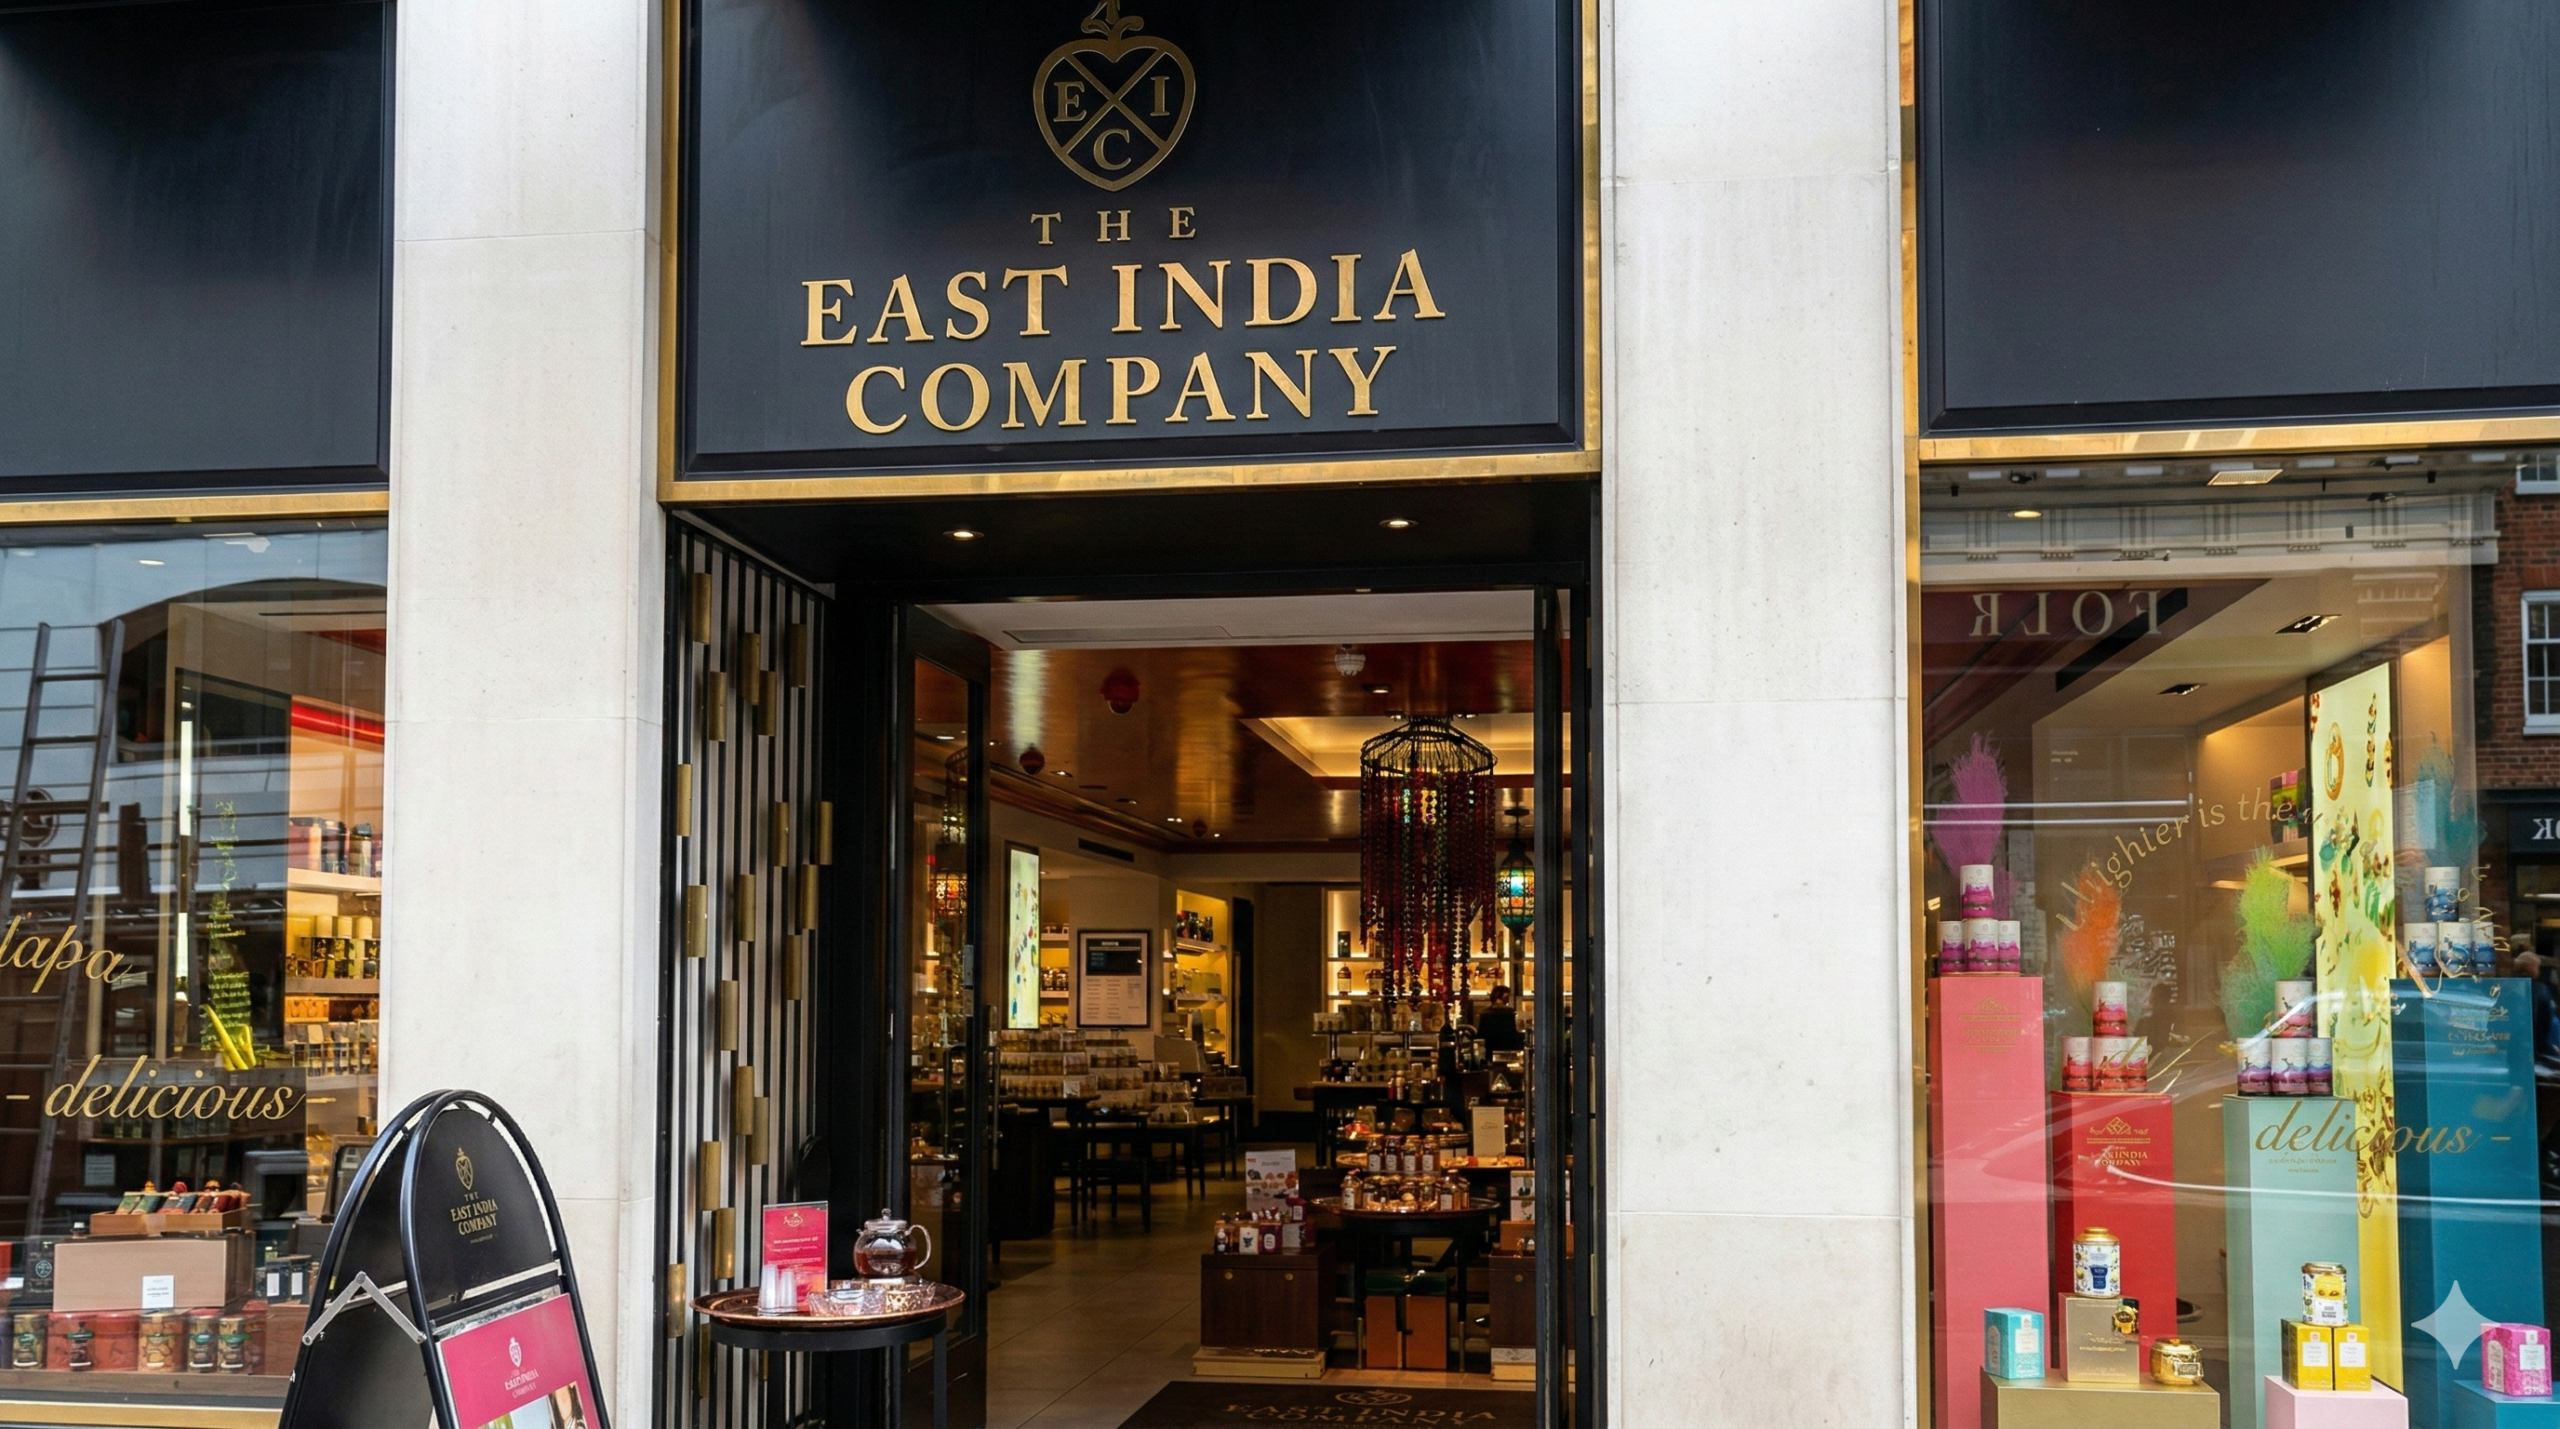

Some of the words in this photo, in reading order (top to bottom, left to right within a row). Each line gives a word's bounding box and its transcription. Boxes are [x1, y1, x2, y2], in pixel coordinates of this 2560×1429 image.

[1030, 206, 1196, 245] THE
[800, 264, 1068, 347] EAST
[1112, 248, 1446, 333] INDIA
[846, 346, 1397, 435] COMPANY
[2198, 798, 2226, 828] is
[44, 1054, 306, 1121] delicious
[2254, 1100, 2482, 1154] delicious
[450, 1204, 472, 1222] EAST
[473, 1198, 499, 1216] INDIA
[458, 1213, 497, 1235] COMPANY
